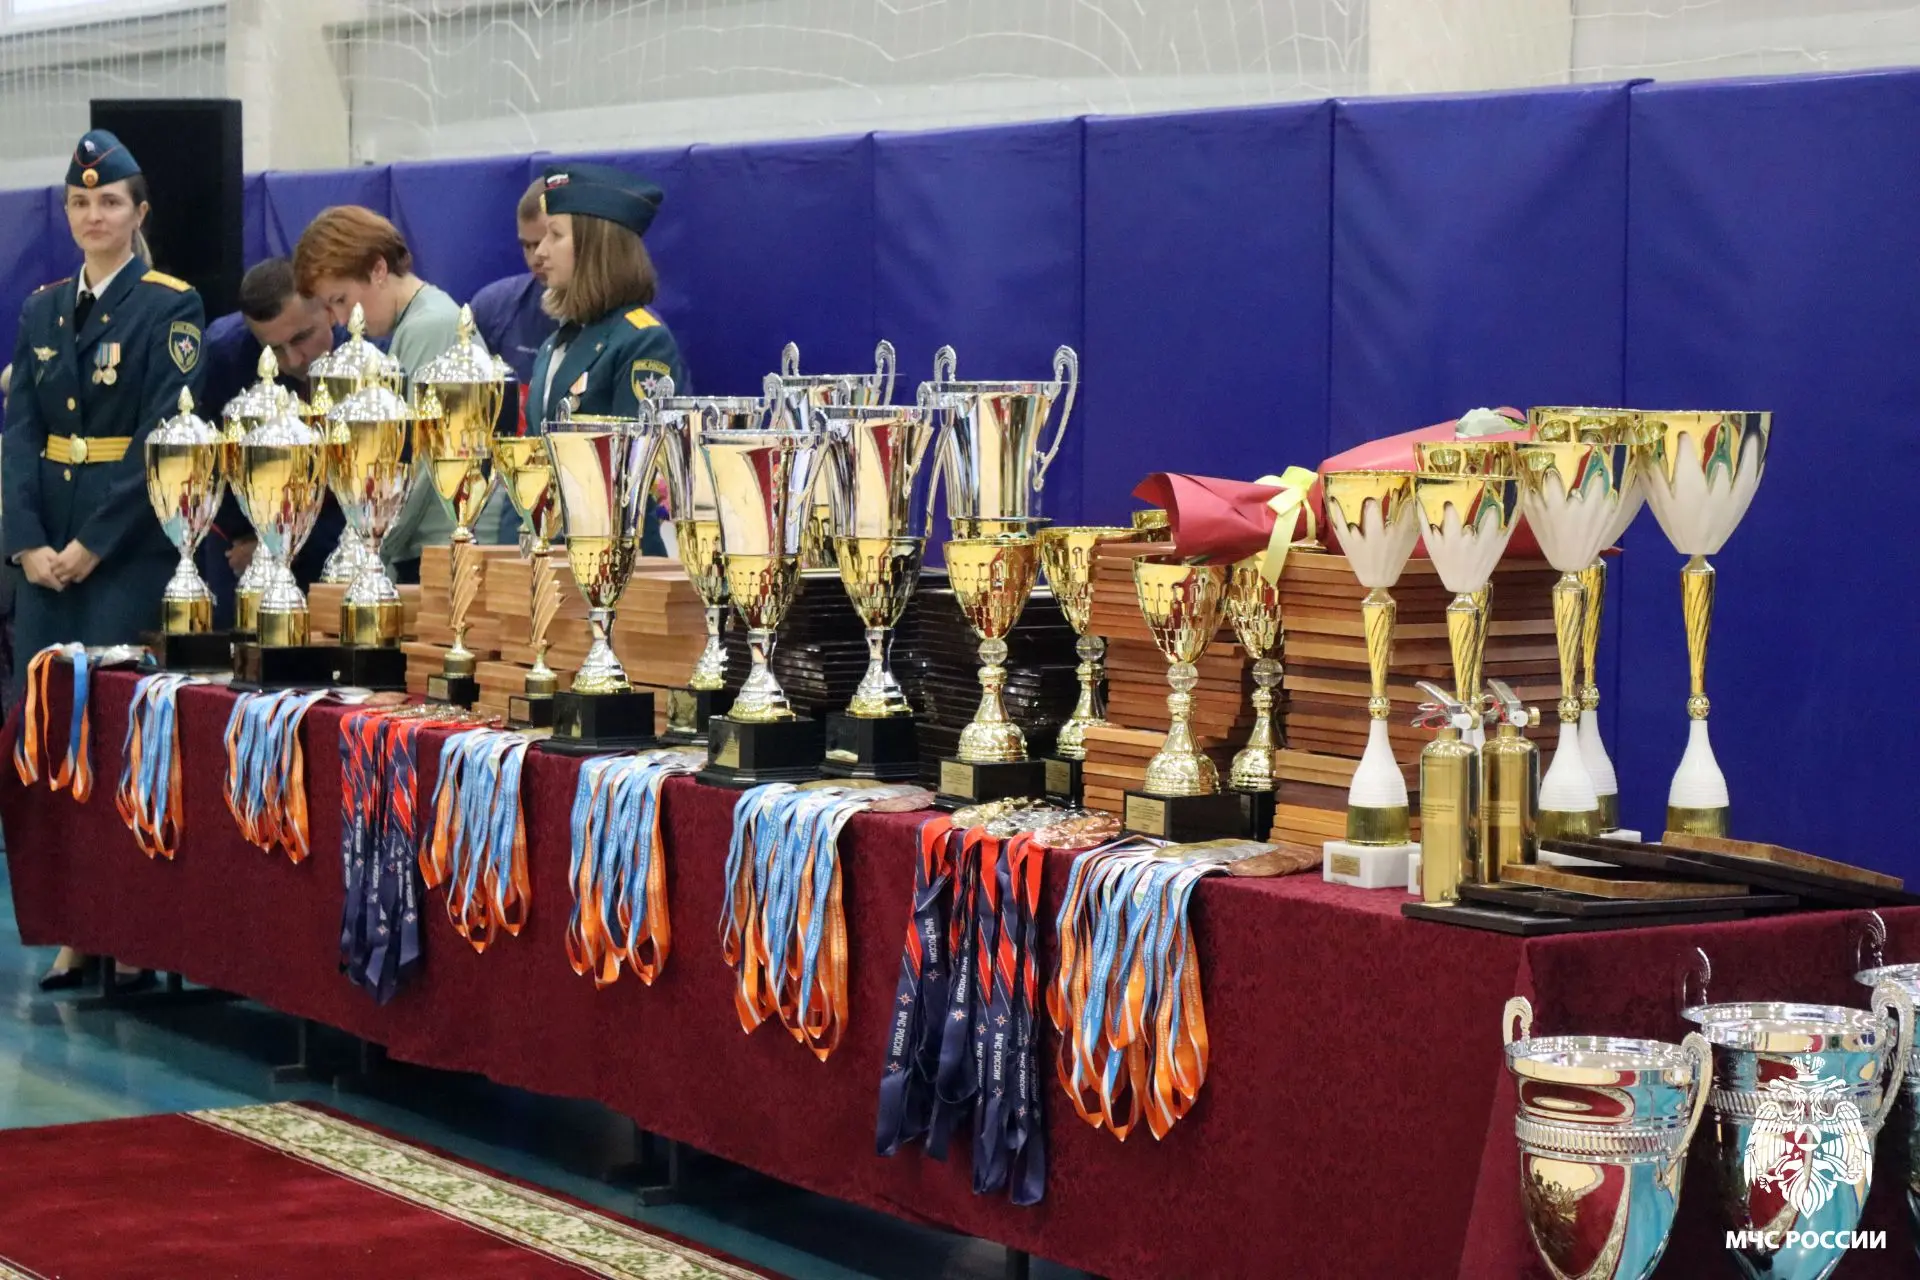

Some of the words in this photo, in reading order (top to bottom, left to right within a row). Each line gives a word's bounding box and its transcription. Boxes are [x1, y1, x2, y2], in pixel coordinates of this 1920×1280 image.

[924, 917, 935, 935] МЧС
[926, 934, 938, 964] РОССИИ
[955, 973, 967, 1004] РОССИИ
[896, 1010, 908, 1027] МЧС
[892, 1027, 905, 1056] РОССИИ
[976, 1041, 984, 1058] МЧС
[993, 1032, 1004, 1050] МЧС
[993, 1050, 1002, 1081] РОССИИ
